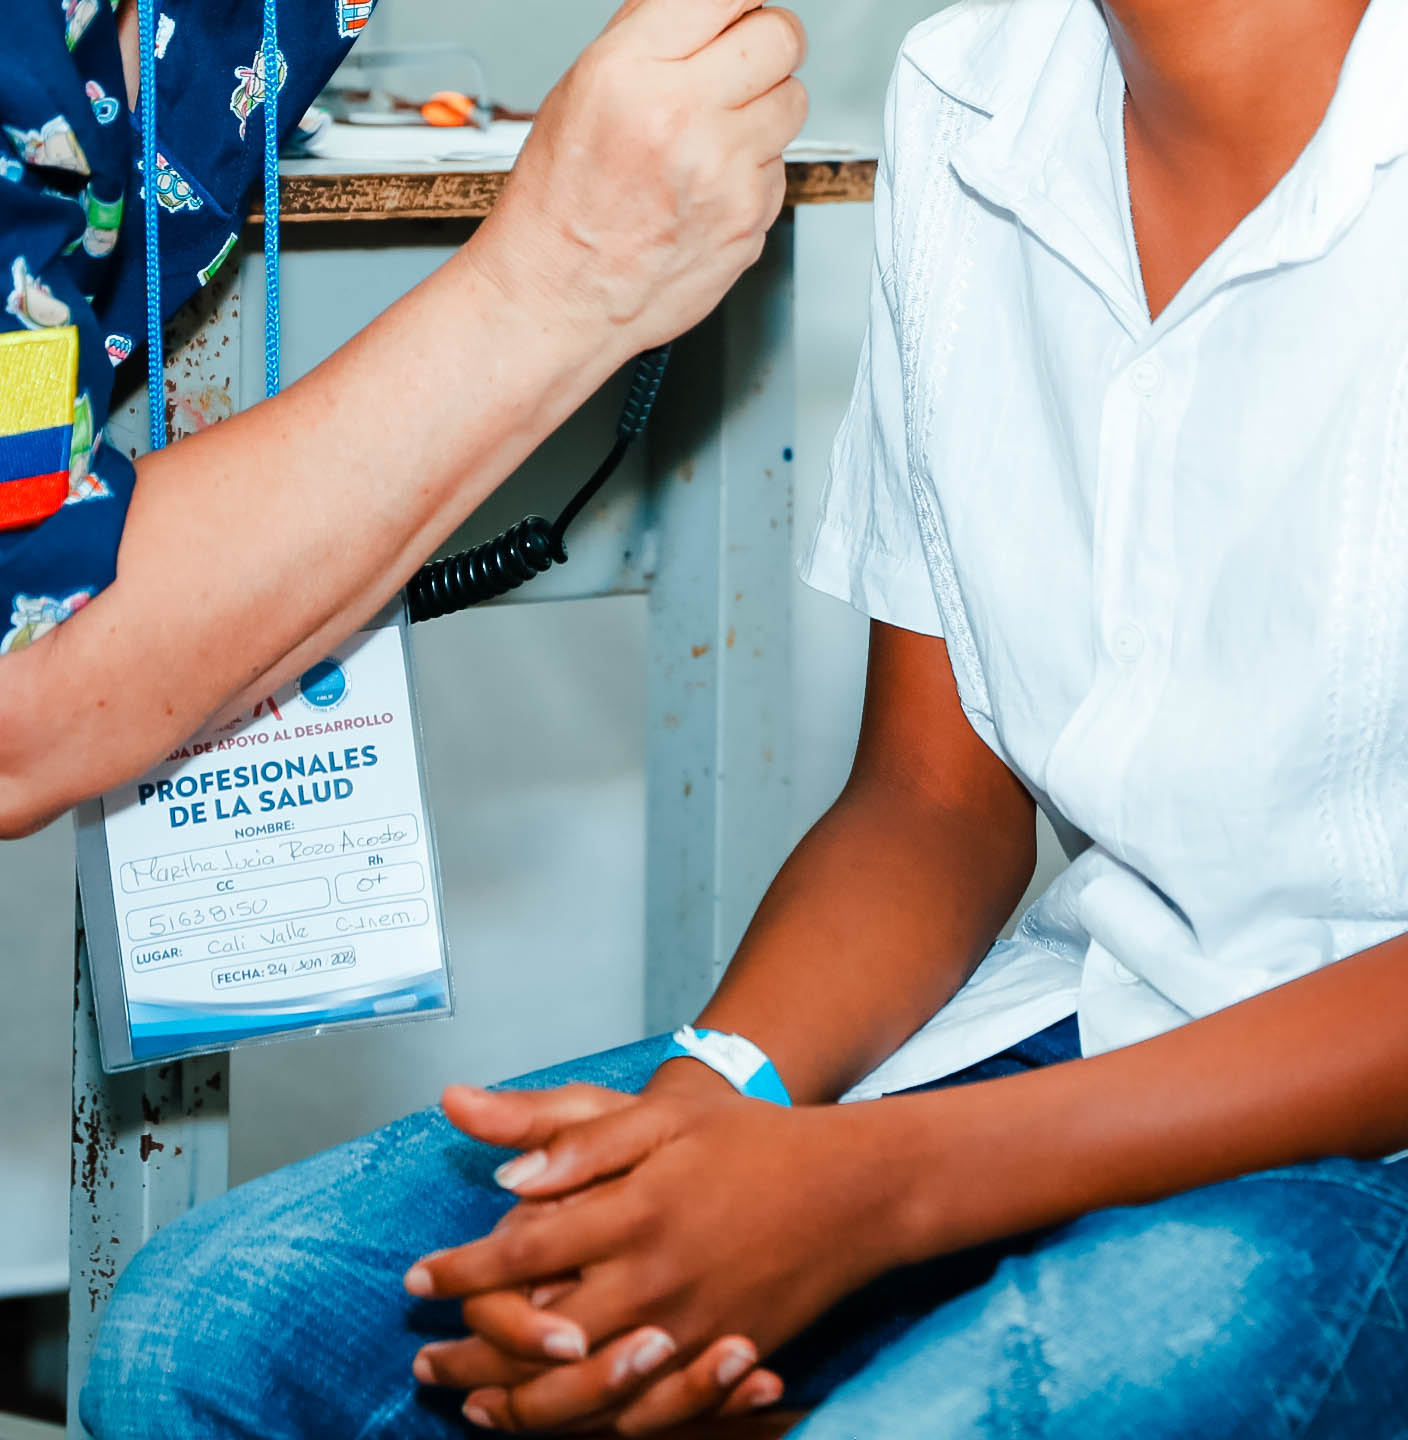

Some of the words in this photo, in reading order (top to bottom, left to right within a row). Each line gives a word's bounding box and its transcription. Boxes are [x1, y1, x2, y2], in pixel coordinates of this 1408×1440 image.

[193, 741, 214, 757] DE
[217, 732, 270, 752] APOYO
[273, 728, 292, 743] AL
[294, 712, 394, 739] DESARROLLO
[138, 744, 379, 806] PROFESIONALES
[169, 801, 207, 828] DE
[215, 795, 252, 820] LA
[259, 777, 354, 812] SALUD
[234, 820, 295, 839] NOMBRE:
[367, 853, 384, 866] Rh
[216, 880, 236, 892] CC
[136, 947, 184, 965] LUGAR:
[217, 967, 265, 985] FECHA:
